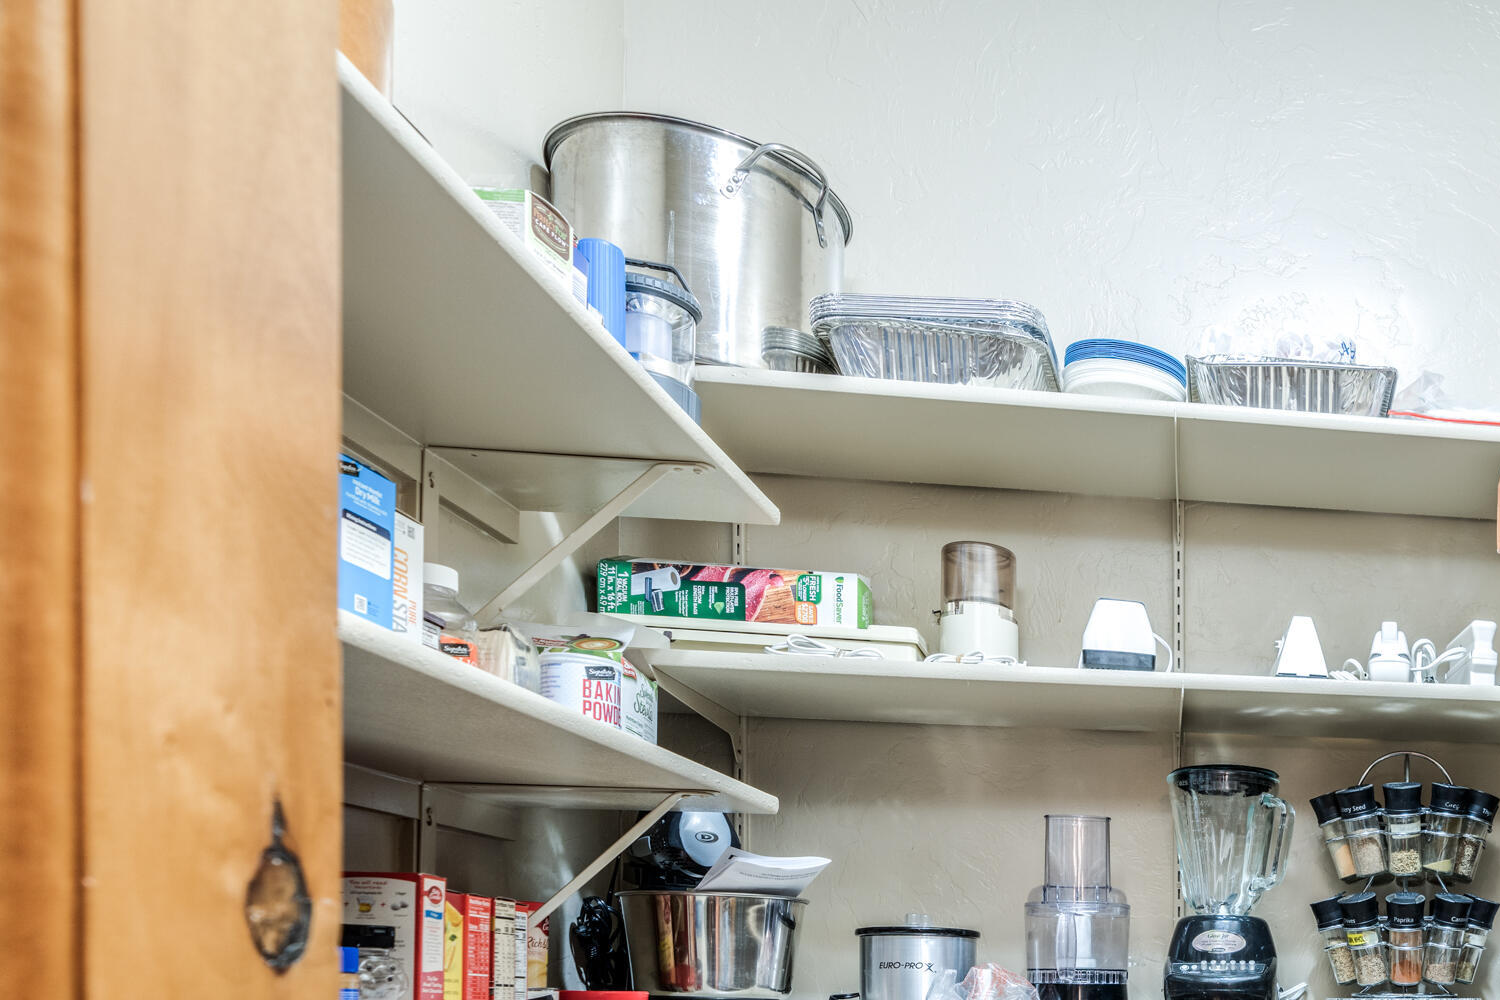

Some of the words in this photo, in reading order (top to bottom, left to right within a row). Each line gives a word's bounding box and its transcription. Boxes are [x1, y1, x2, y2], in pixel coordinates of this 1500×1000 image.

[393, 546, 409, 601] CORN
[809, 575, 817, 602] FRESH
[607, 592, 616, 603] 16
[836, 584, 844, 625] FoodSaver
[1352, 803, 1367, 812] Seed
[1393, 916, 1415, 925] Paprika
[878, 960, 923, 971] EURO-PRO
